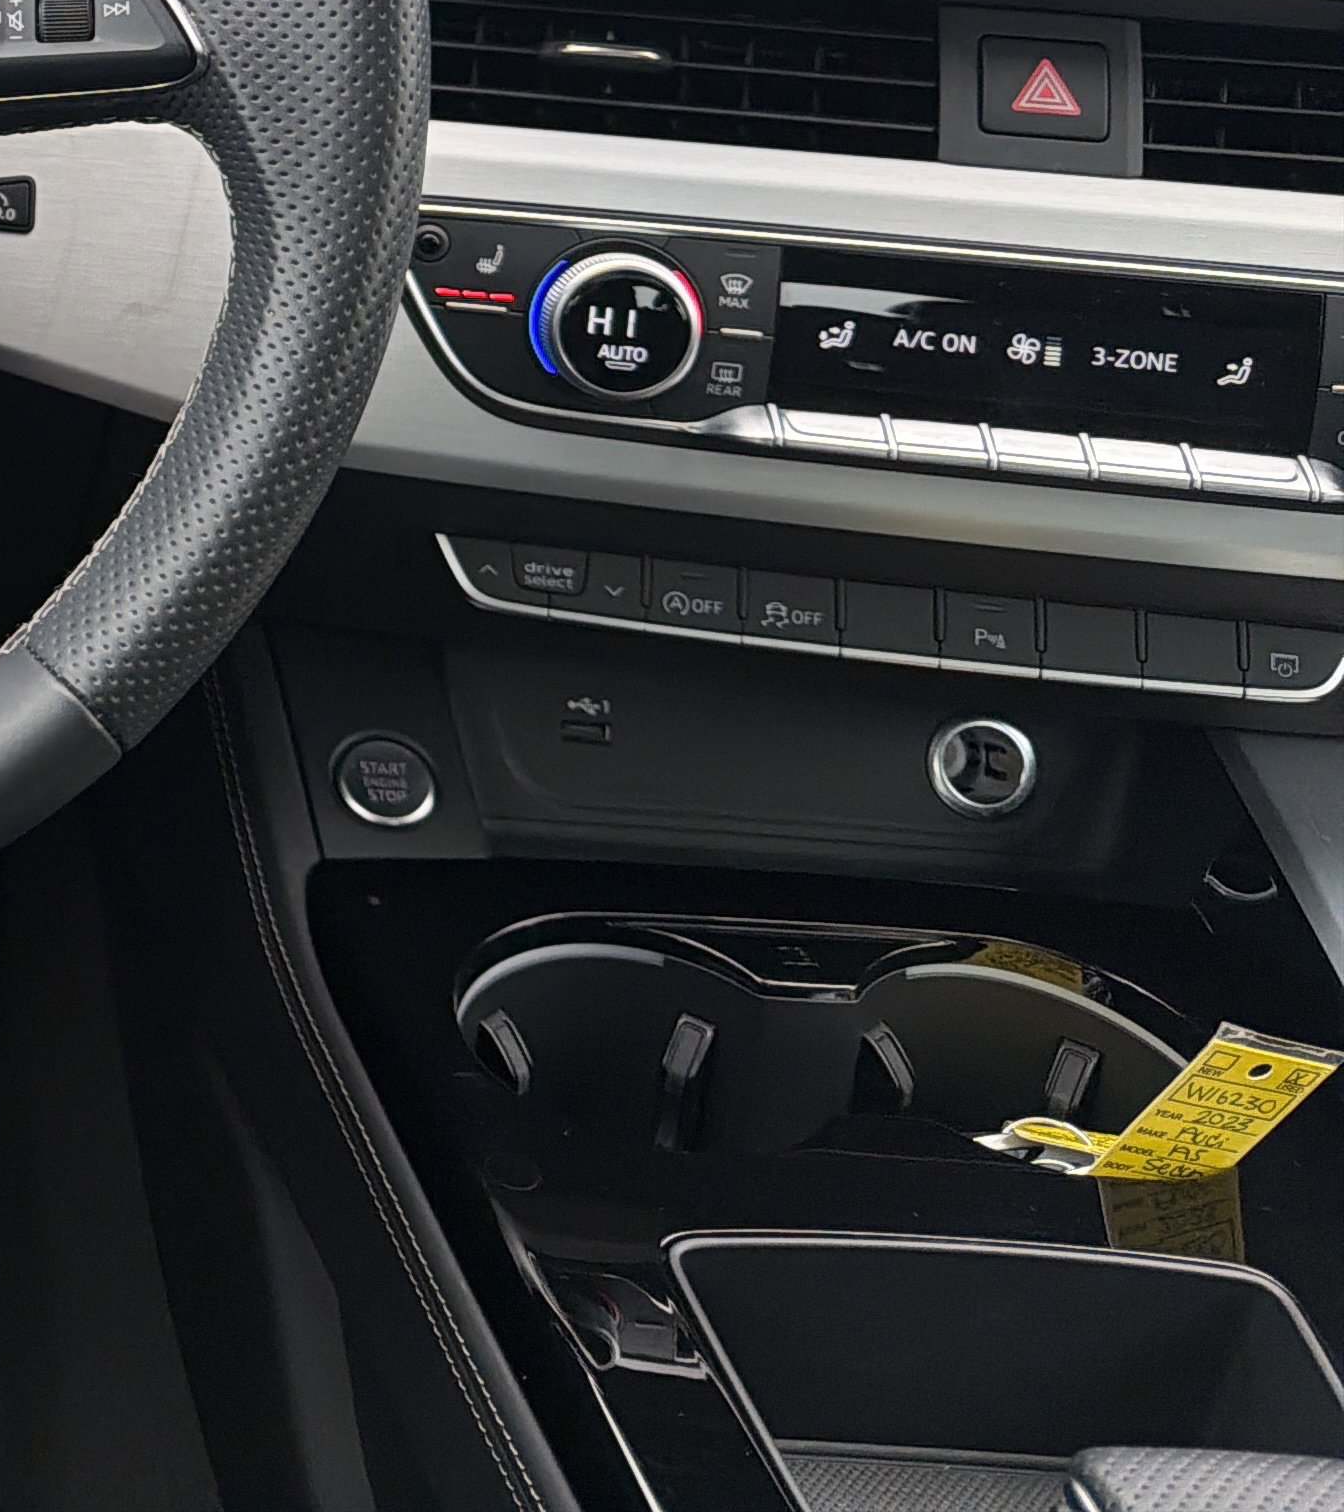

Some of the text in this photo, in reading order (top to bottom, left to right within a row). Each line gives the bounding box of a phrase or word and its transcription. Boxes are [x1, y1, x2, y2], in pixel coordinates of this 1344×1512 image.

[718, 295, 750, 309] MAX
[893, 328, 976, 355] A/C ON
[596, 343, 649, 363] AUTO
[1091, 347, 1178, 373] 3-ZONE
[706, 383, 743, 399] REAR
[524, 561, 574, 578] drive
[524, 575, 574, 590] select
[691, 599, 724, 615] OFF
[792, 612, 824, 627] OFF
[359, 760, 407, 775] START
[368, 788, 407, 802] STOP
[1198, 1066, 1224, 1077] NEW
[1156, 1108, 1254, 1132] YEAR 2023
[1136, 1126, 1168, 1139] MAKE
[1119, 1143, 1154, 1157] MODEL
[1102, 1161, 1134, 1171] BODY
